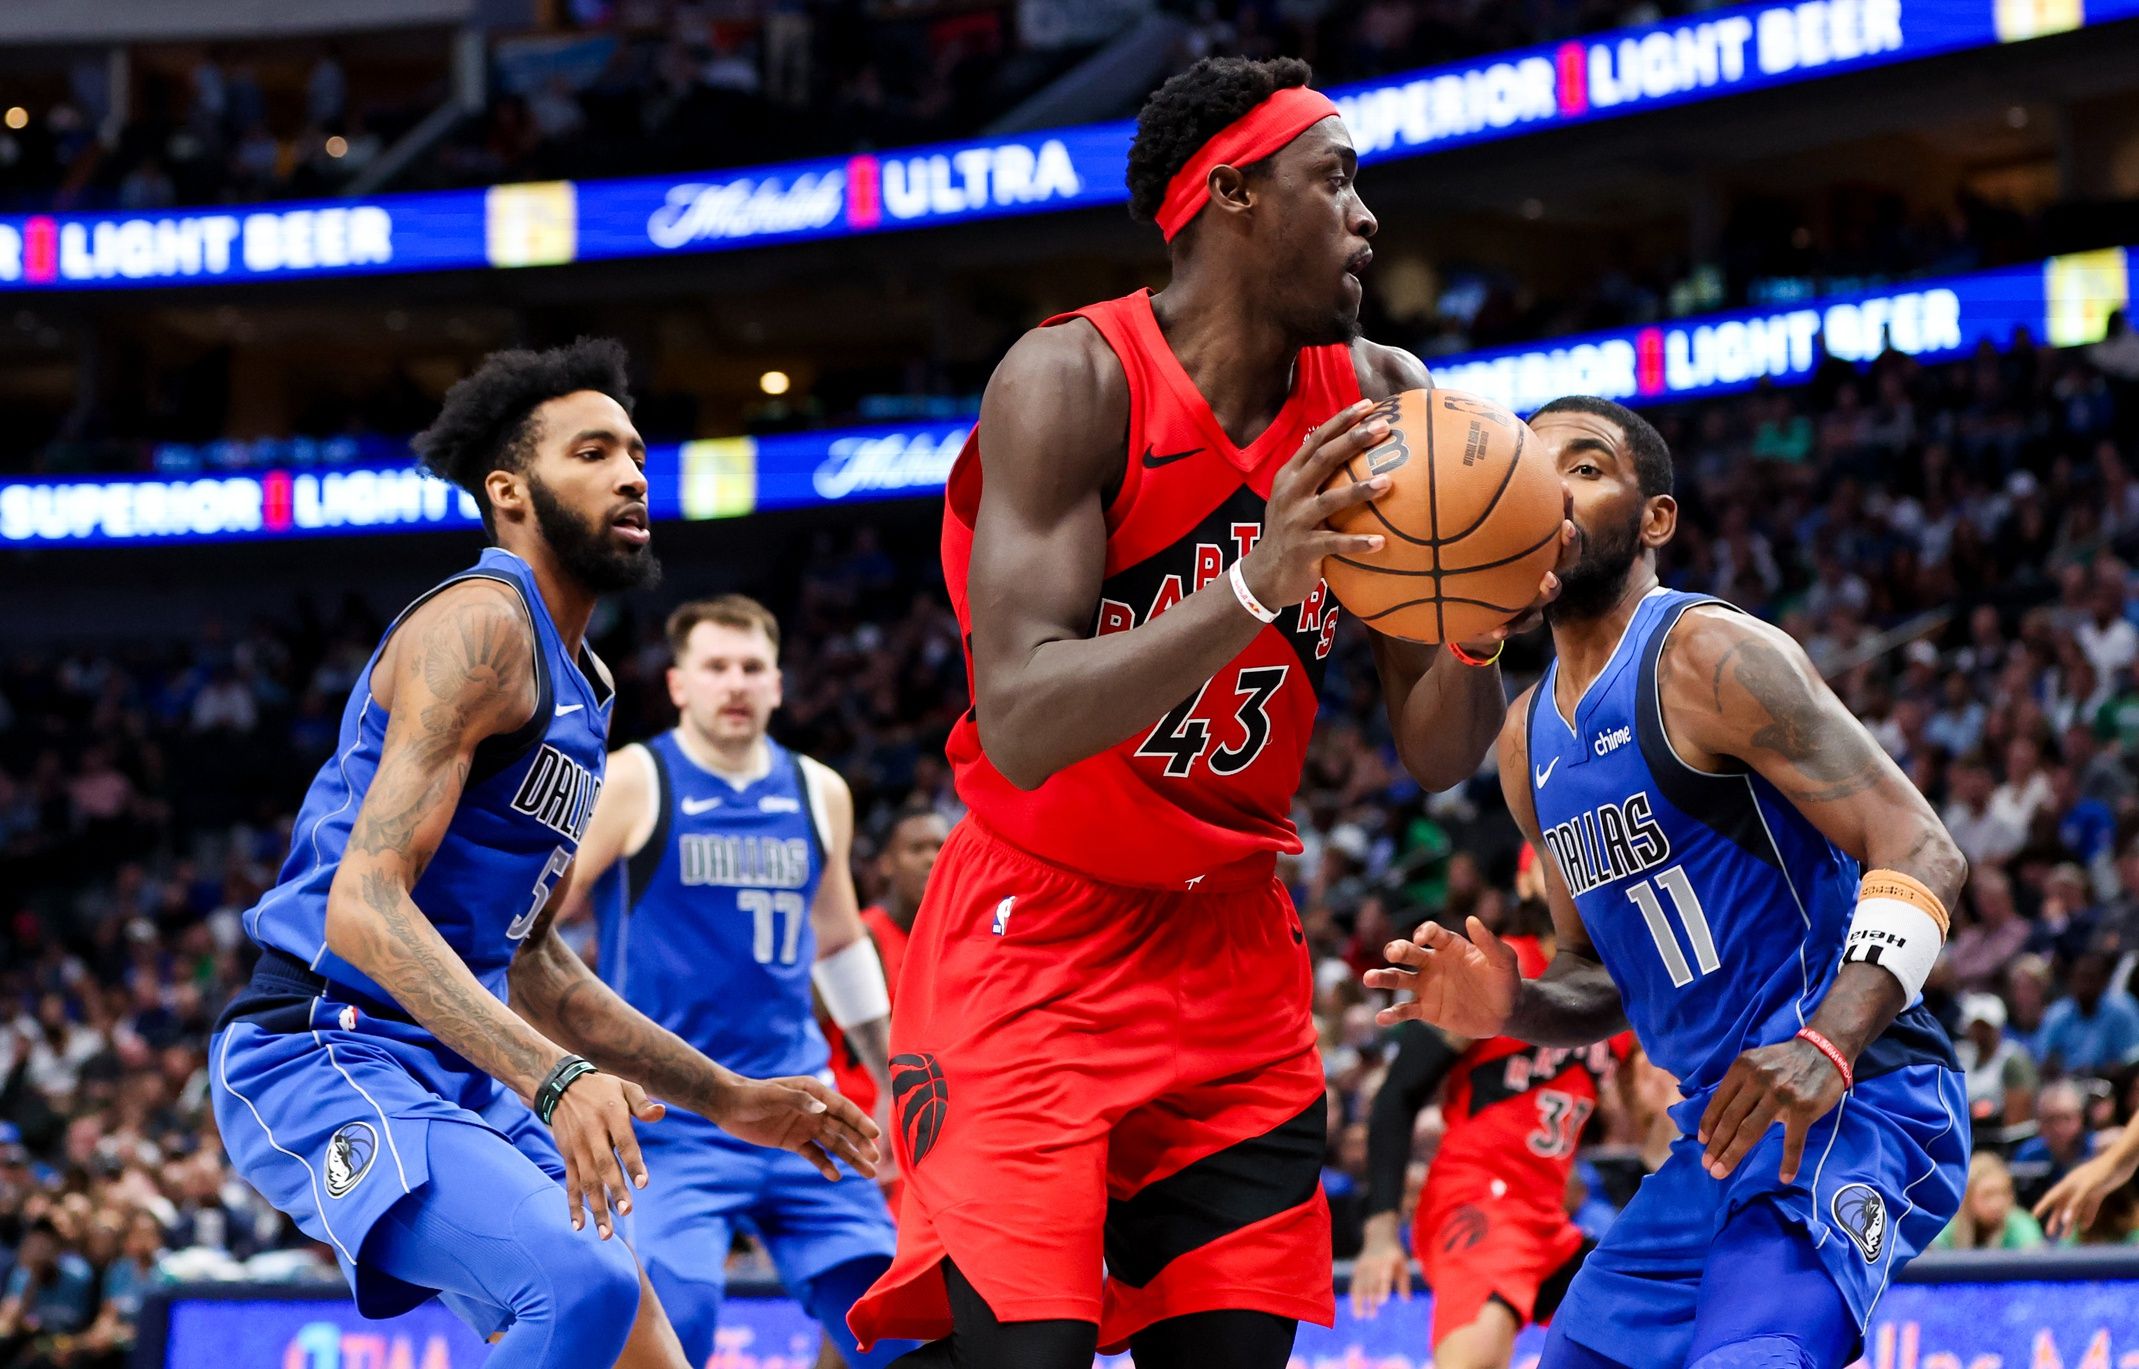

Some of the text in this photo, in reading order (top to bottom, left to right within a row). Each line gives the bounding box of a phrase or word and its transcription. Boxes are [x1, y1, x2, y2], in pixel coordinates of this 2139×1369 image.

[1587, 16, 1752, 107] LIGHT
[1757, 0, 1903, 74] BEER
[882, 139, 1081, 219] ULTRA
[60, 215, 240, 279] LIGHT
[243, 206, 393, 271] BEER
[1664, 310, 1821, 390] LIGHT
[0, 477, 264, 540] SUPERIOR
[1096, 521, 1340, 661] RAPTRS
[1133, 665, 1290, 779] 43
[1593, 725, 1633, 757] chime
[678, 832, 810, 889] DALLAS
[1543, 791, 1671, 900] DALLAS
[505, 845, 574, 941] 5
[736, 888, 805, 965] 77
[1625, 864, 1722, 989] 11
